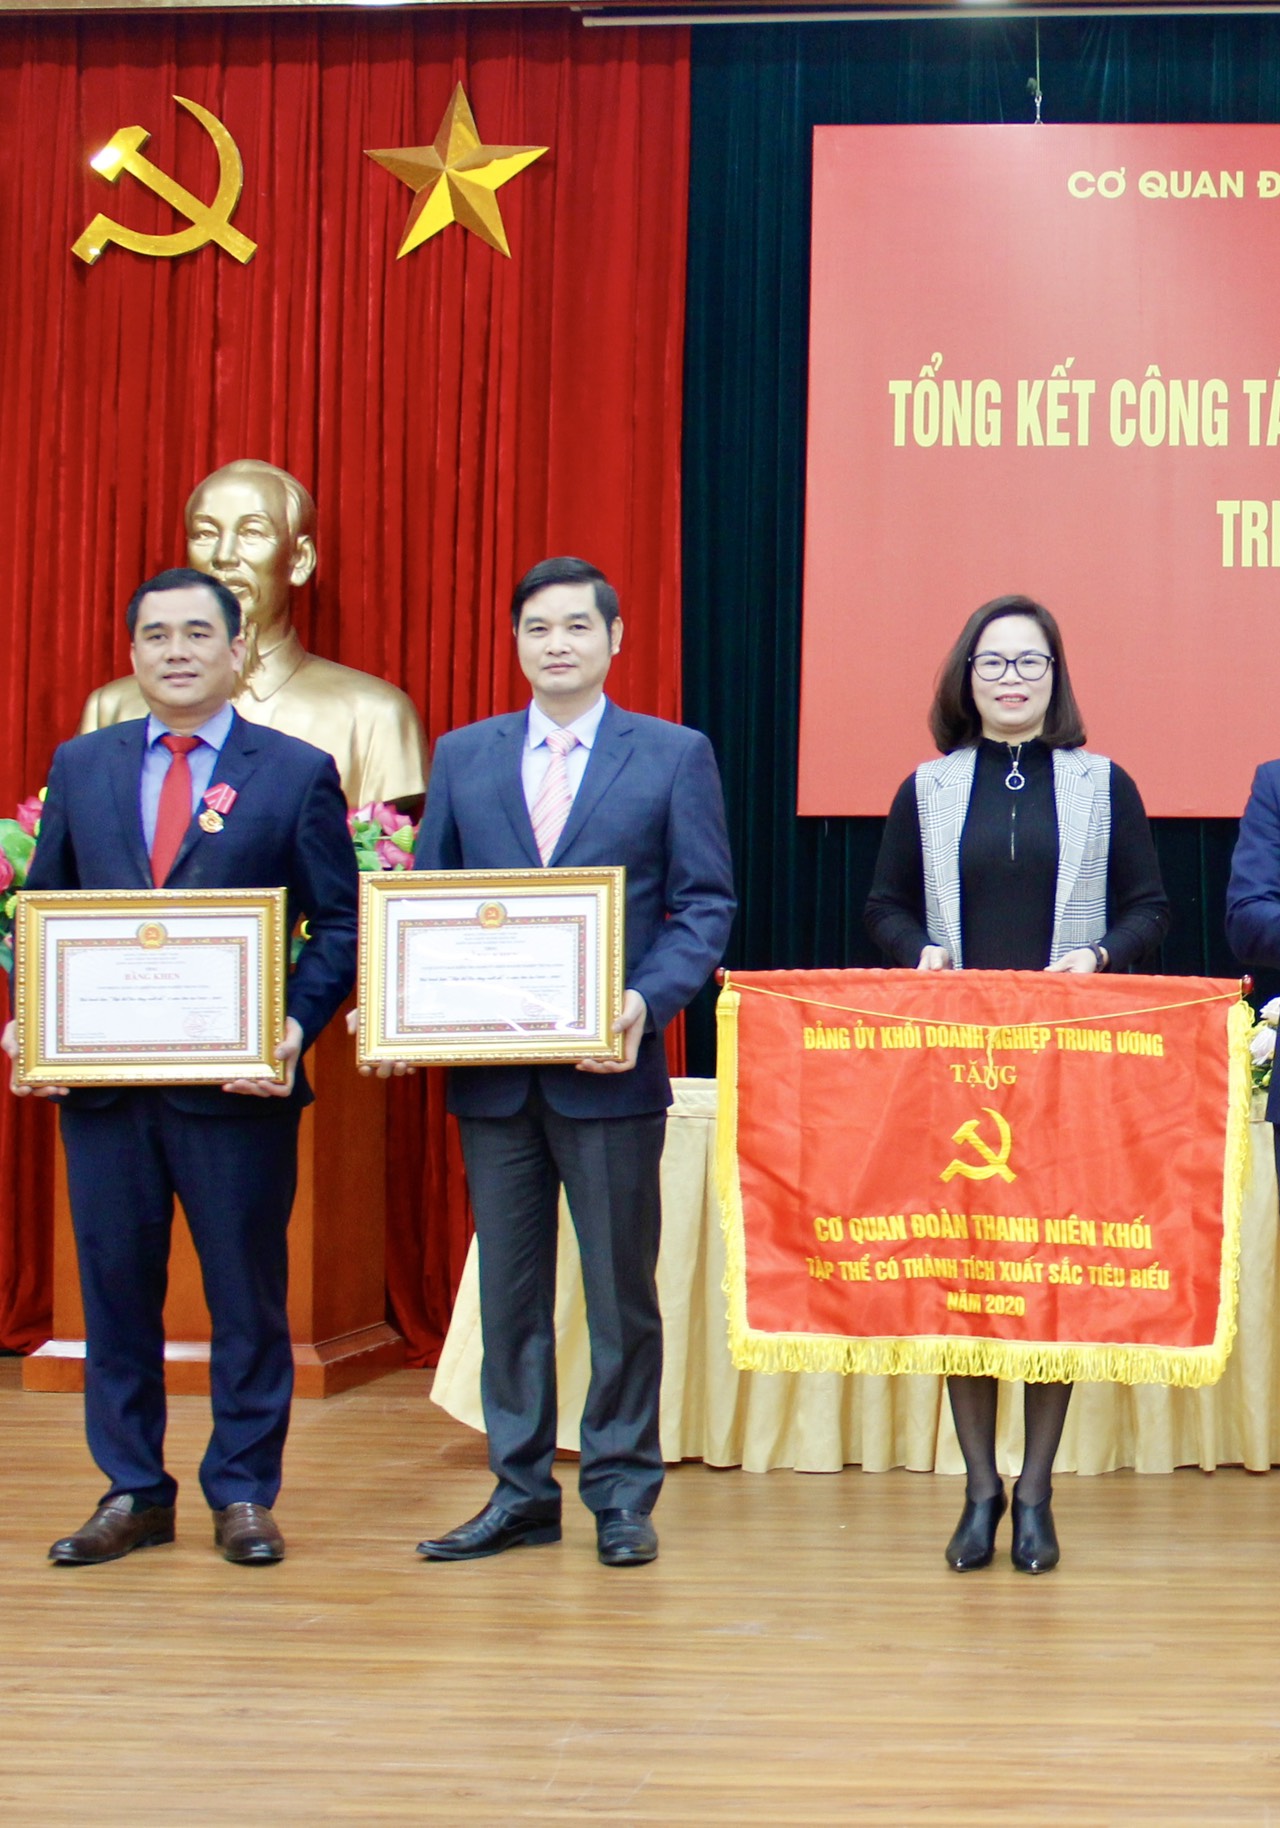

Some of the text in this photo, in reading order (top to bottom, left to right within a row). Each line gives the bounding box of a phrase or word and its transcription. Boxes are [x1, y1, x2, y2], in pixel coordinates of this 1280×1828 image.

[1068, 169, 1126, 199] CƠ
[1138, 171, 1244, 200] QUAN
[888, 352, 1002, 448] TỔNG
[1016, 357, 1097, 448] KẾT
[1109, 364, 1229, 448] CÔNG
[804, 1020, 850, 1050] ĐẢNG
[855, 1020, 875, 1049] ỦY
[926, 1026, 983, 1049] DOANH
[1056, 1028, 1112, 1054] TRUNG
[1117, 1030, 1164, 1057] ƯƠNG
[950, 1060, 1017, 1088] TẶNG
[813, 1208, 1153, 1250] CƠ QUAN ĐOÀN THANH NIÊN KHỐI
[839, 1254, 872, 1282] THỂ
[875, 1254, 900, 1281] CÓ
[902, 1254, 958, 1280] THÀNH
[961, 1255, 995, 1281] TÍCH
[998, 1256, 1043, 1284] XUẤT
[1048, 1256, 1083, 1286] SẮC
[1088, 1264, 1125, 1288] TIÊU
[1130, 1261, 1170, 1291] BIỂU
[947, 1289, 1026, 1318] NĂM 2020
